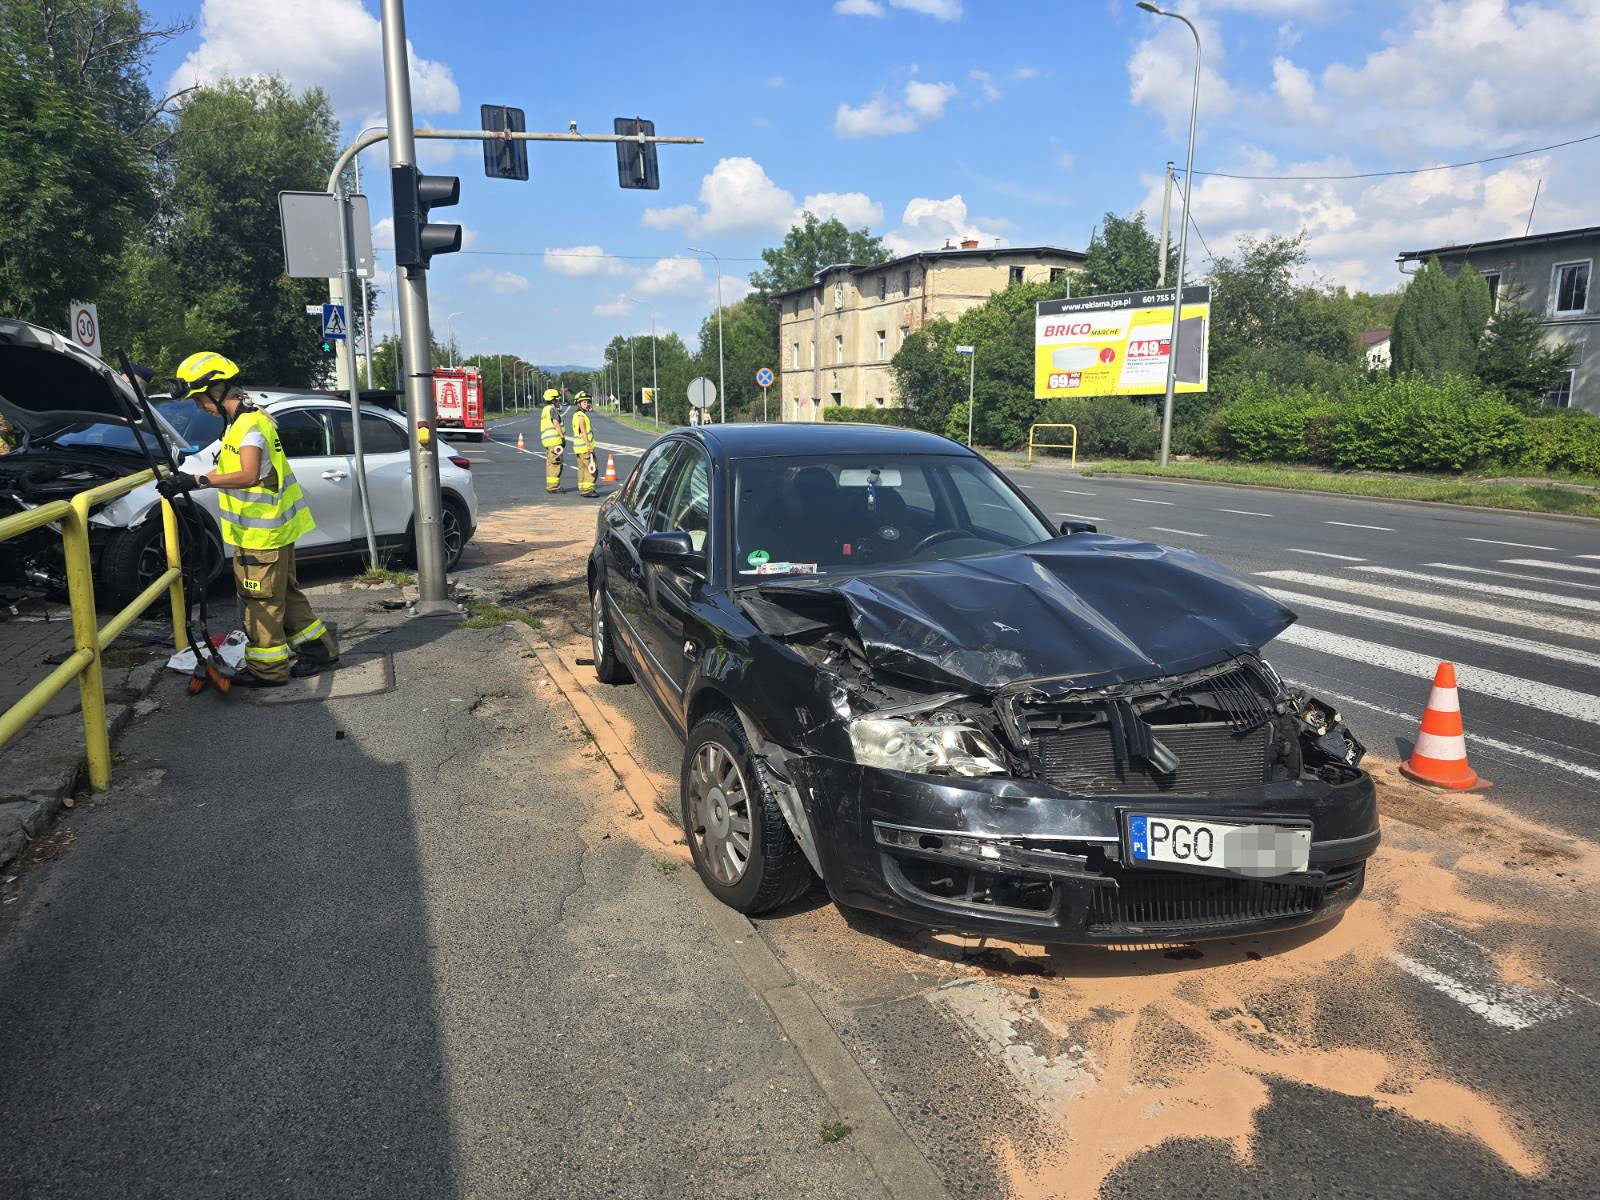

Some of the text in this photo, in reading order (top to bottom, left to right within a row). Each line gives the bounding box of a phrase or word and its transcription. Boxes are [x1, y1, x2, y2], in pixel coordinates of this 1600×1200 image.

[1061, 297, 1131, 311] www.reklama.jga.pl
[1142, 295, 1155, 303] 601
[1156, 294, 1169, 302] 755
[79, 319, 93, 337] 30
[1044, 323, 1091, 337] BRICO
[1133, 842, 1146, 853] PL
[1150, 821, 1213, 862] PGO
